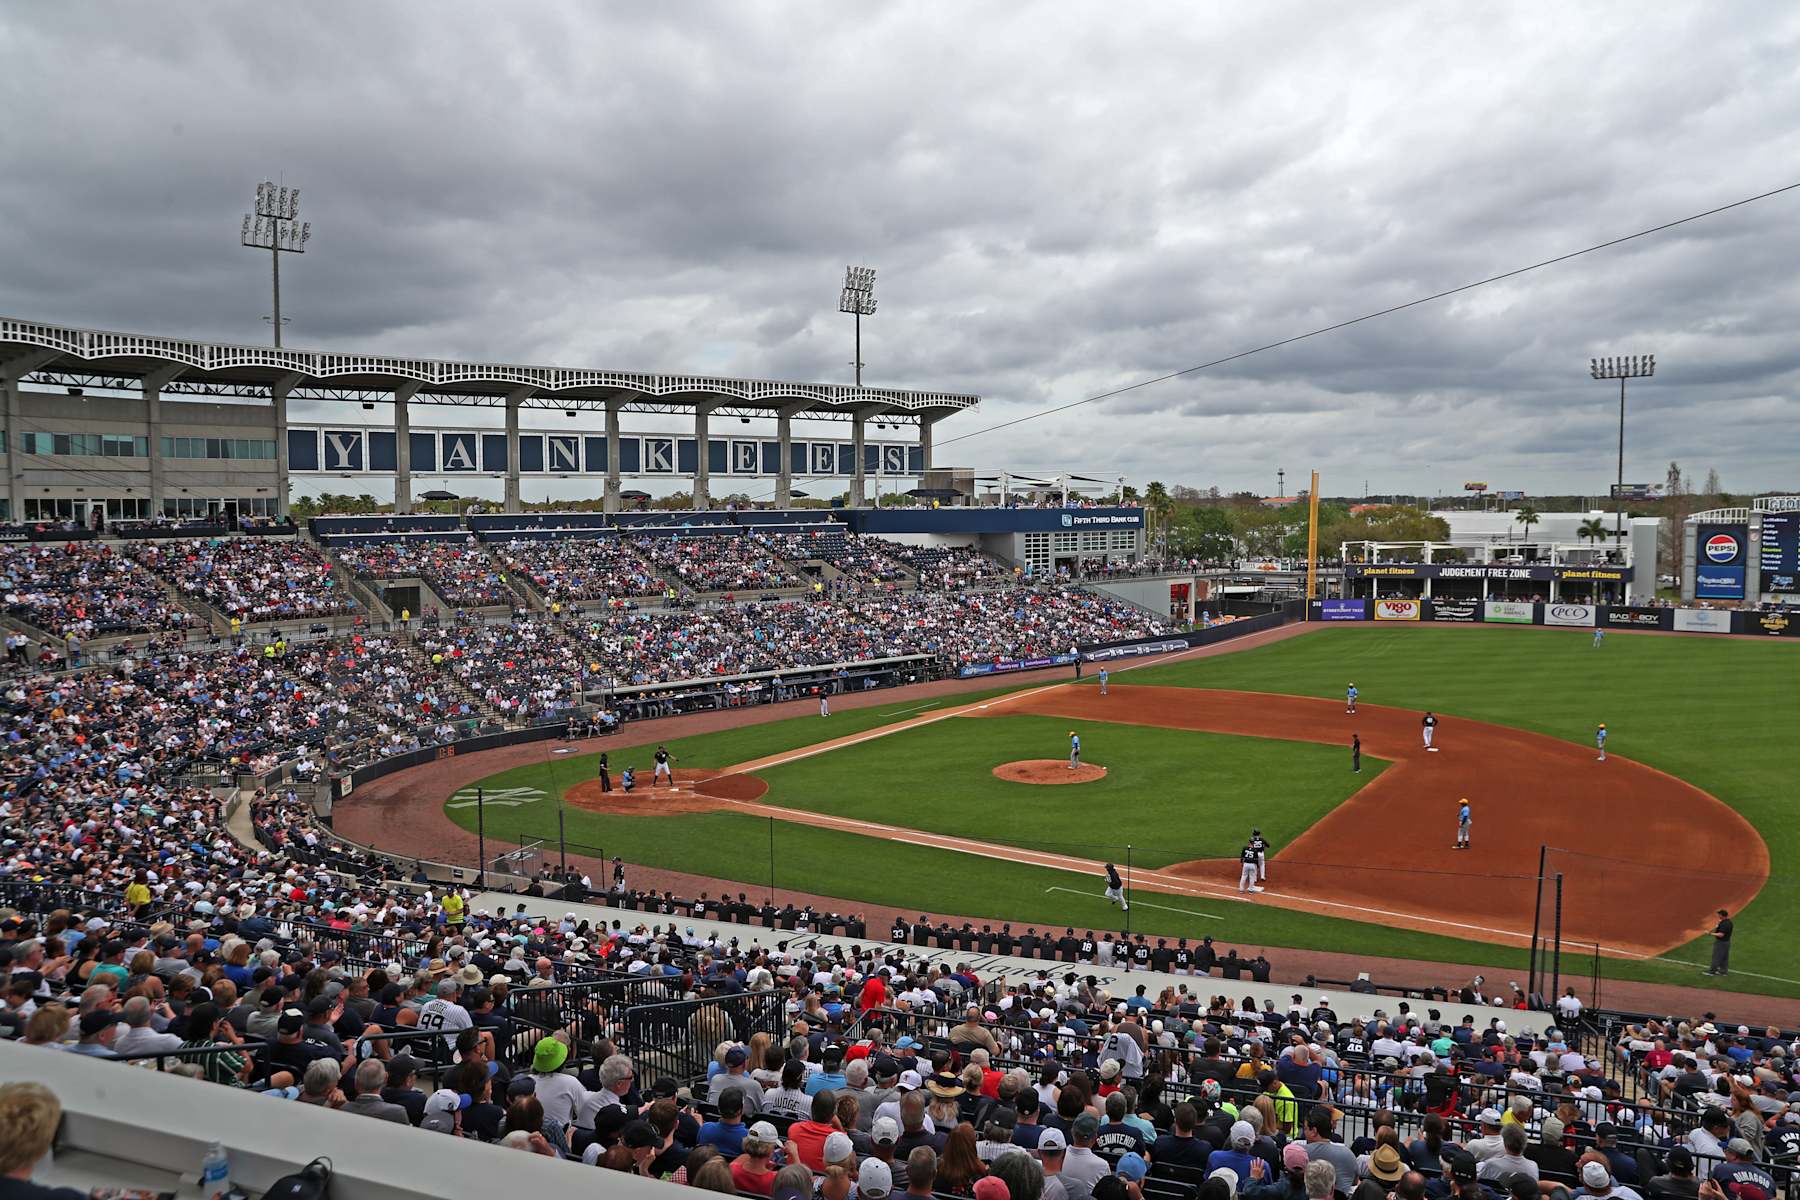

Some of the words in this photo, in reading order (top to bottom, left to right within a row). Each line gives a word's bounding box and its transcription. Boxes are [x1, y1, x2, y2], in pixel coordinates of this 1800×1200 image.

[326, 433, 902, 472] YANKEES
[1073, 516, 1091, 524] FIFTH
[1091, 516, 1110, 524] THIRD
[1363, 567, 1388, 576] planet
[1388, 567, 1415, 575] fitness
[1440, 567, 1486, 577] JUDGEMENT
[1487, 568, 1508, 577] FREE
[1509, 568, 1531, 579] ZONE
[1562, 570, 1591, 579] planet
[1591, 571, 1622, 580] fitness
[1557, 607, 1582, 617] PCC
[1244, 849, 1254, 858] 75
[799, 912, 809, 921] 31
[892, 929, 904, 939] 33
[1081, 941, 1092, 953] 18
[1116, 945, 1128, 955] 34
[1135, 949, 1148, 959] 40
[1176, 953, 1187, 963] 14
[421, 1013, 445, 1030] 99
[1107, 1035, 1119, 1051] 2
[1733, 1171, 1770, 1189] DIMAGGIO
